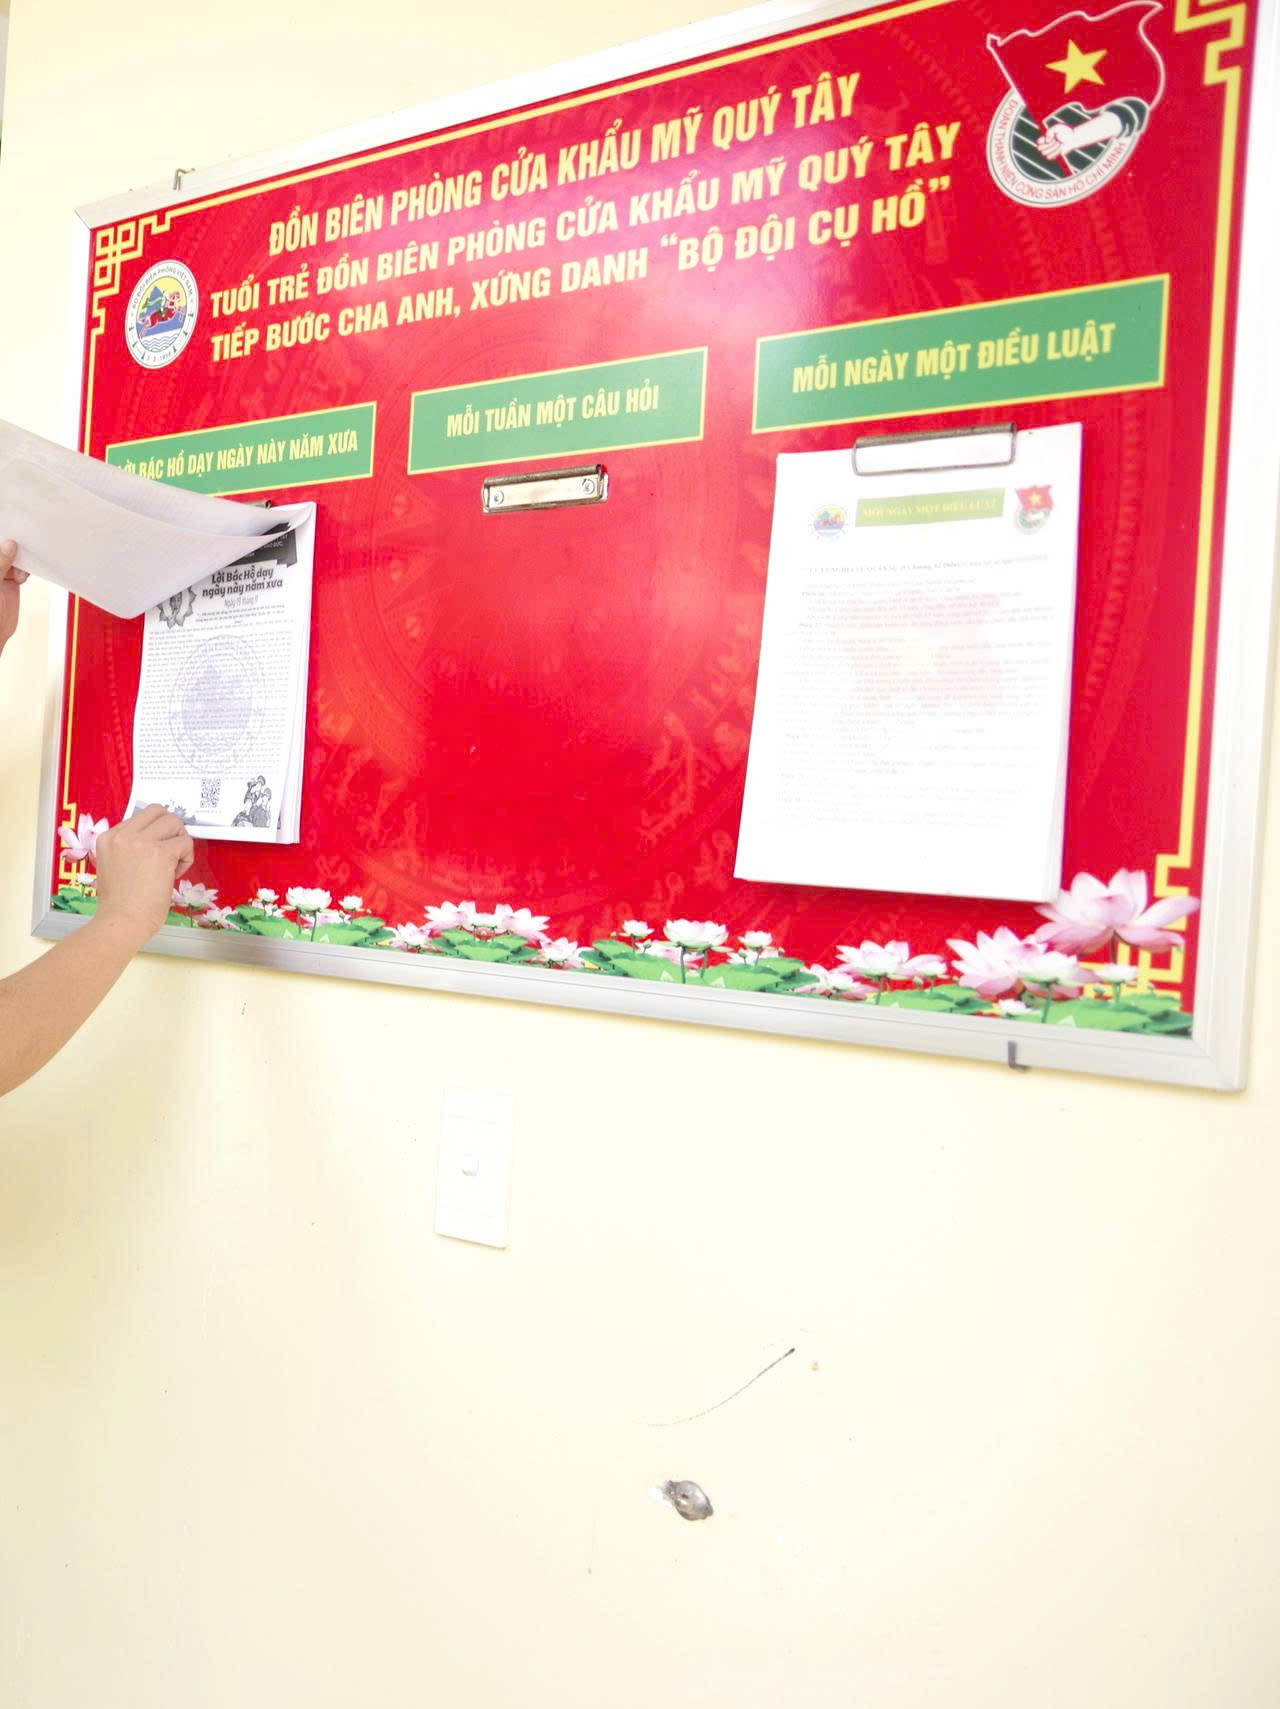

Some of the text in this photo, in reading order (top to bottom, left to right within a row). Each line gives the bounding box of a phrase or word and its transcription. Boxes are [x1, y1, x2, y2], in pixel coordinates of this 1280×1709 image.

[269, 71, 860, 256] ĐỒN BIÊN PHÒNG CỬA KHẨU MỸ QUÝ TÂY
[210, 121, 961, 318] TUỔI TRẺ ĐỒN BIÊN PHÒNG CỬA KHẨU MỸ QUÝ TÂY
[211, 175, 951, 363] TIẾP BƯỚC CHA ANH, XỨNG DANH “BỘ ĐỘI CỤ HỒ”
[792, 320, 1116, 393] MỖI NGÀY MỘT ĐIỀU LUẬT
[447, 378, 659, 437] MỖI TUẦN MỘT CÂU HỎI
[138, 456, 164, 480] BÁC
[167, 449, 185, 478] HỒ
[188, 451, 214, 477] DẠY
[217, 443, 254, 471] NGÀY
[257, 441, 287, 465] NÀY
[289, 433, 323, 460] NĂM
[328, 429, 359, 455] XƯA
[202, 578, 283, 599] ngày này năm xưa
[211, 565, 273, 584] Lời Bác Hồ dạy
